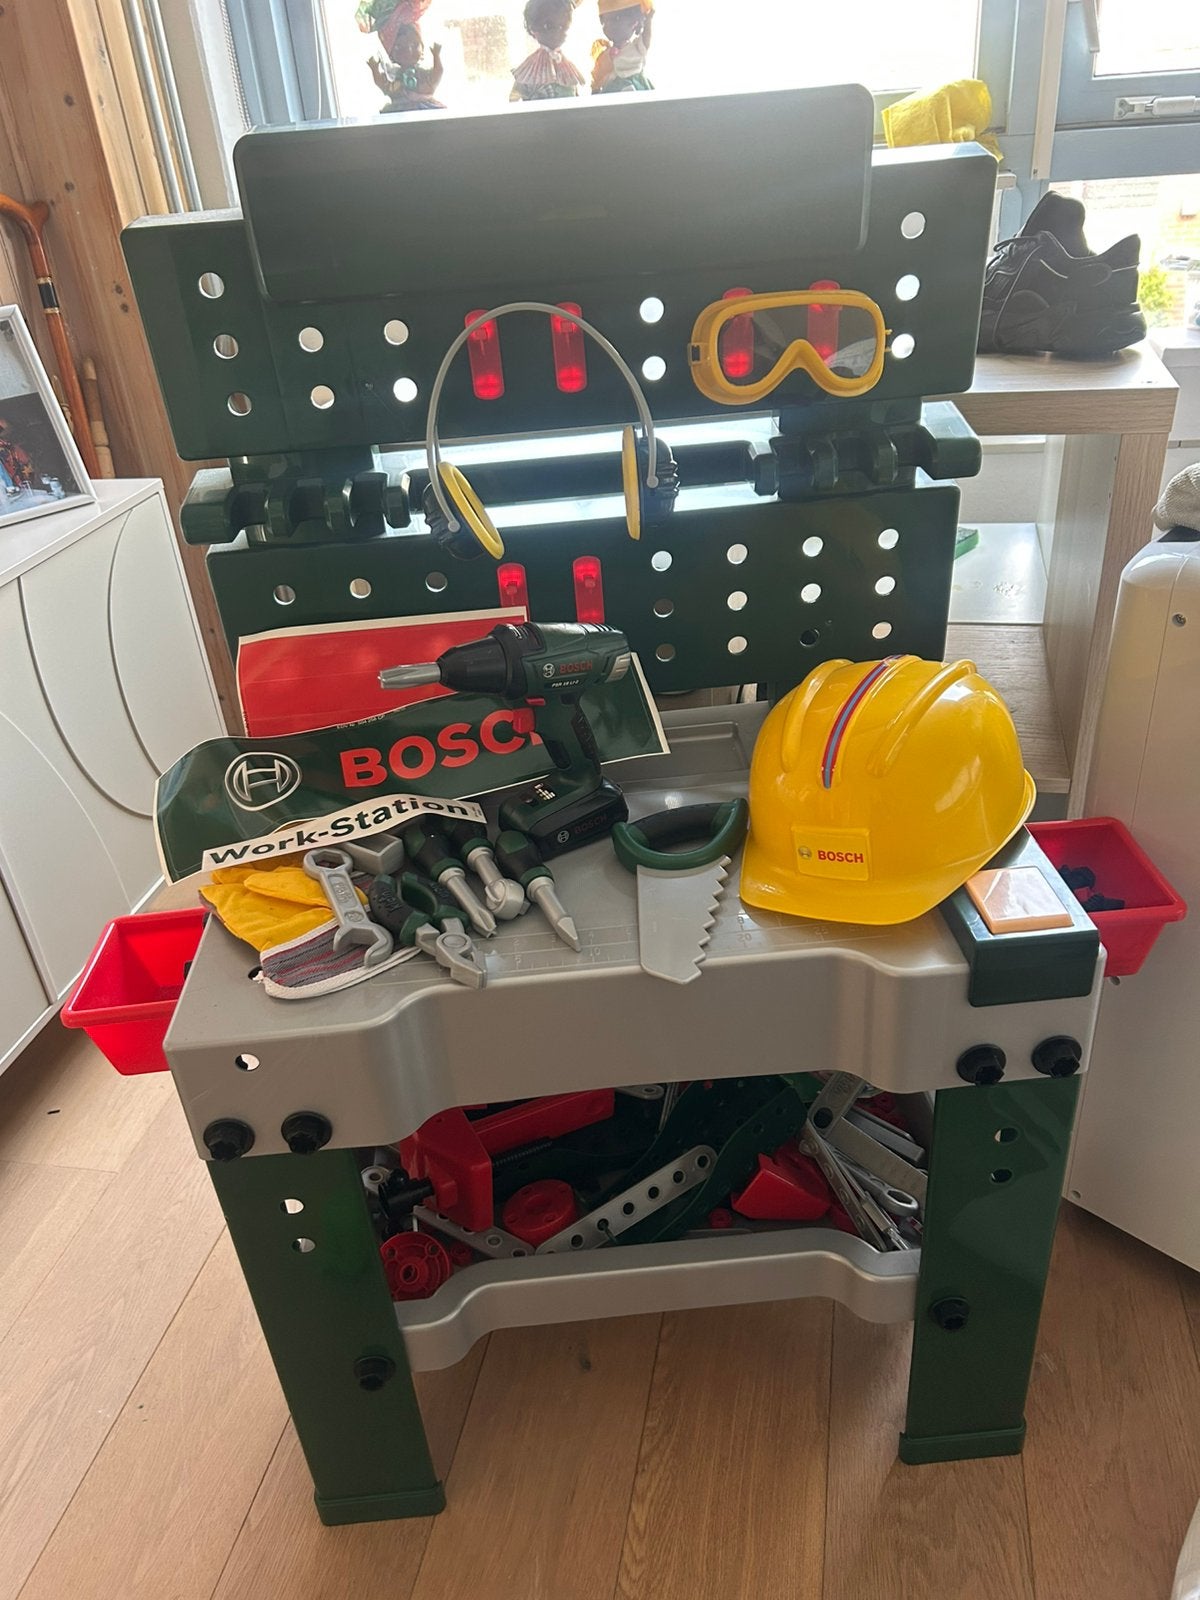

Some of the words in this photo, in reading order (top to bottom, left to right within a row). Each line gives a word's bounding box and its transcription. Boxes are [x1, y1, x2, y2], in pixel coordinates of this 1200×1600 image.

[559, 661, 593, 674] BOSCH
[340, 709, 543, 787] BOSC
[210, 797, 468, 864] Work-Station
[574, 813, 608, 835] BOSCH
[817, 849, 864, 864] BOSCH
